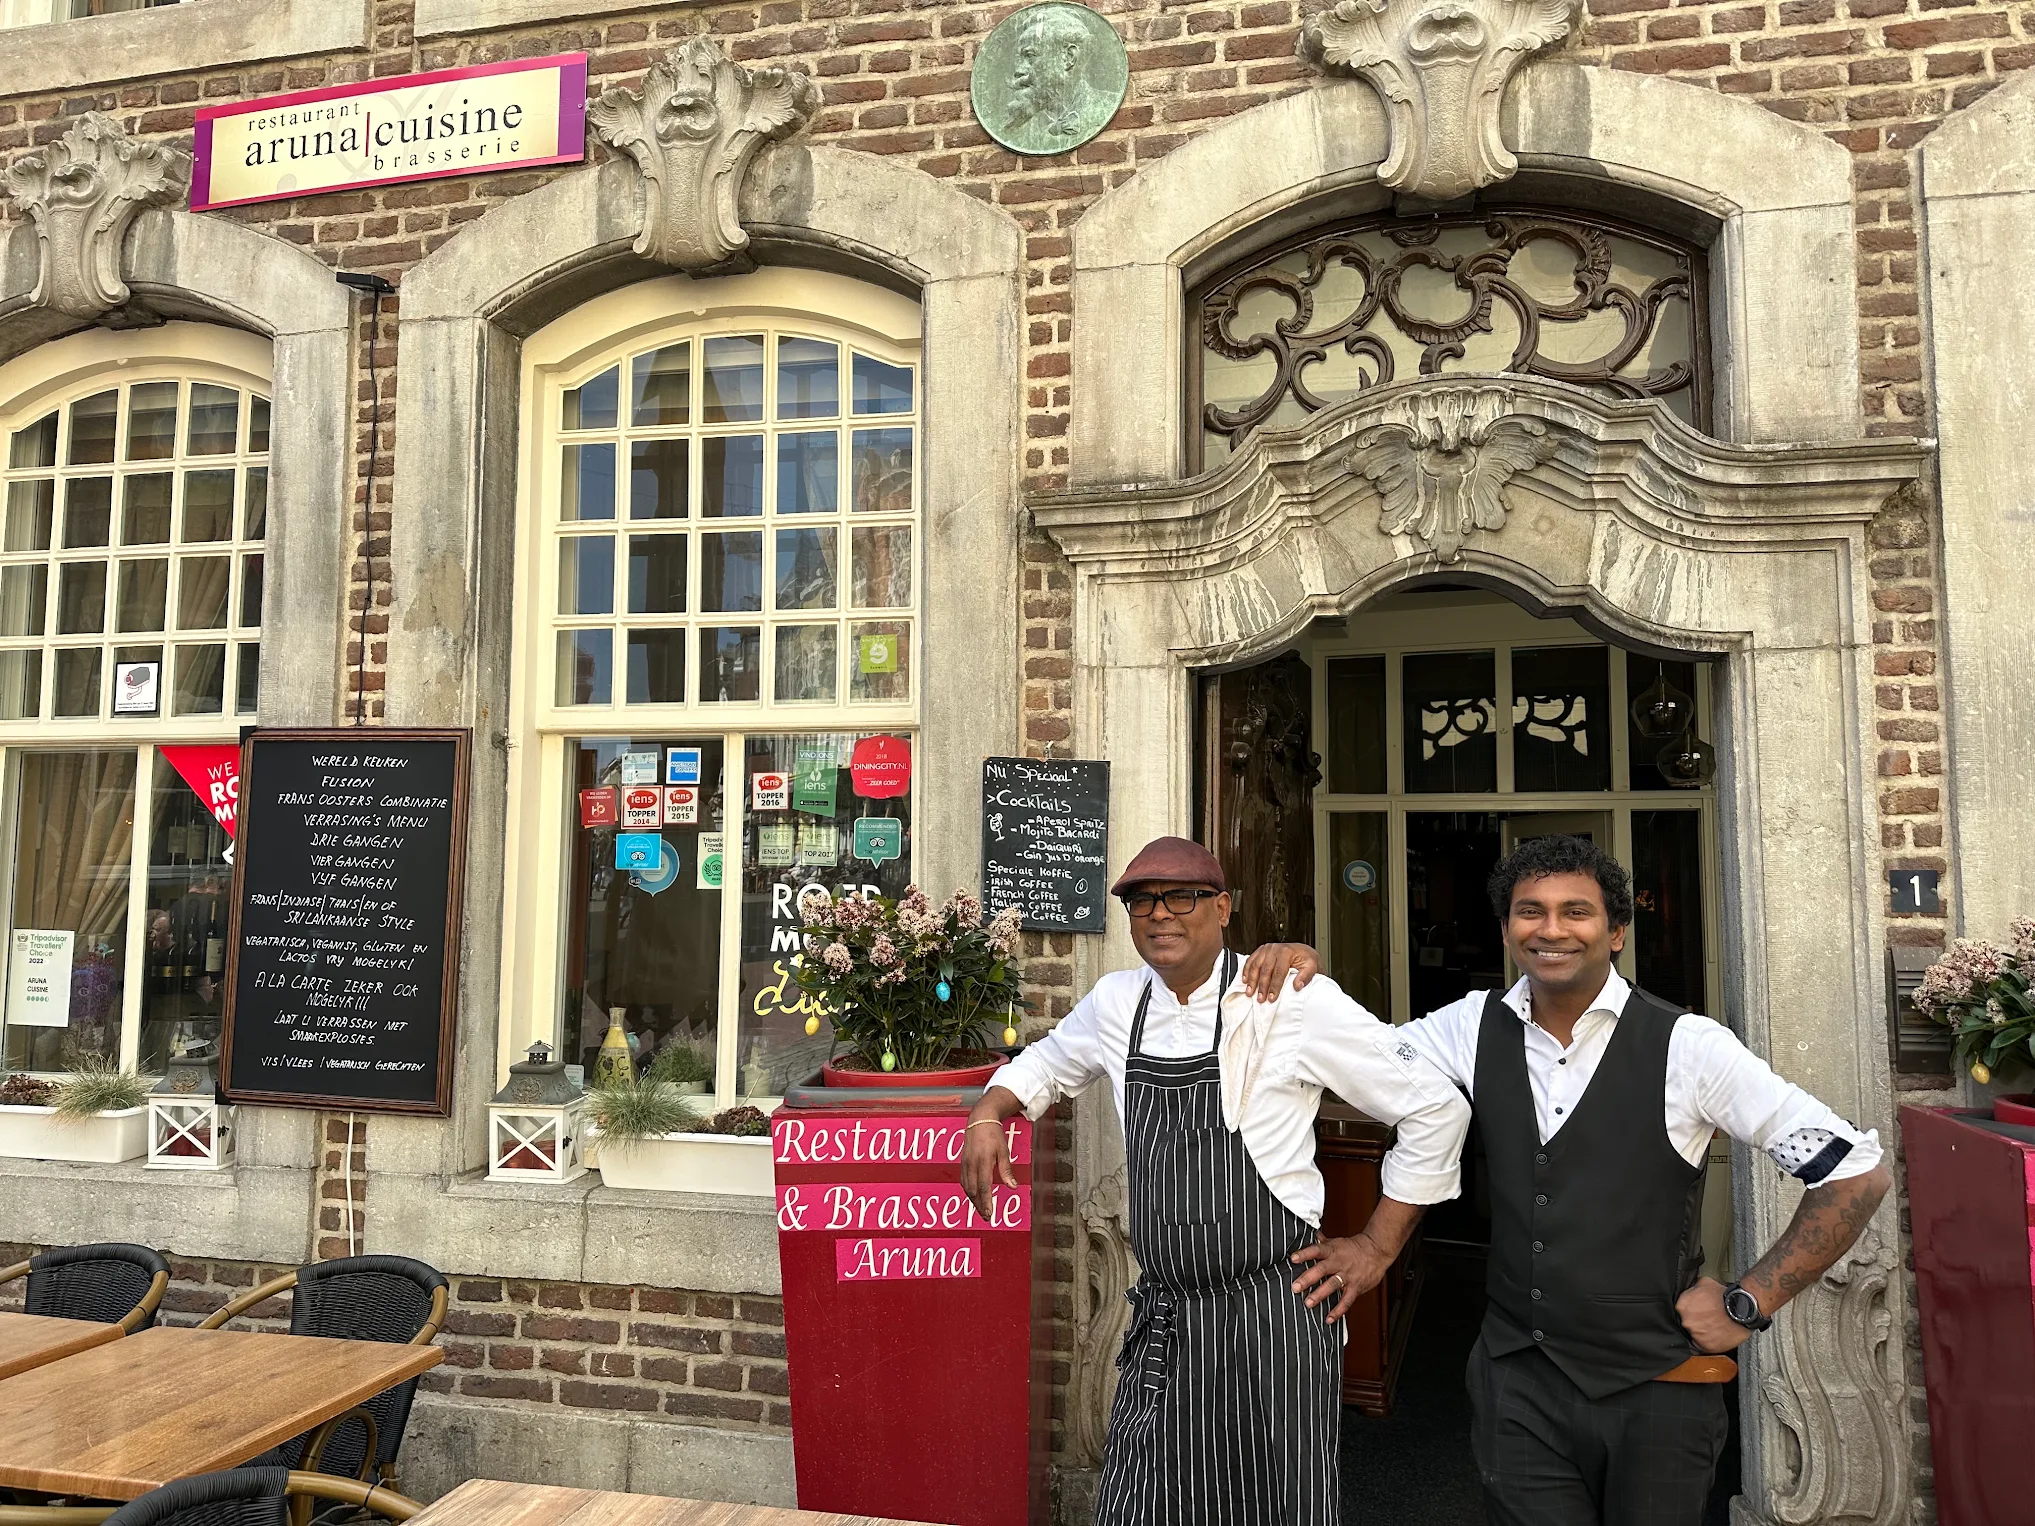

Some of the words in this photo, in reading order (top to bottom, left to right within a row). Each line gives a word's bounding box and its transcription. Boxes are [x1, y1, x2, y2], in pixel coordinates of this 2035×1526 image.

[248, 102, 360, 132] restaurant
[245, 123, 360, 167] aruna
[375, 99, 523, 146] cuisine
[374, 138, 520, 170] brasserie
[363, 756, 408, 767] KEUKEN
[854, 762, 908, 770] DININGCITY.NL
[207, 762, 234, 780] WE
[321, 776, 375, 788] FUSION
[804, 780, 826, 790] iens
[277, 793, 314, 805] FRANS
[319, 795, 373, 806] OOSTERS
[631, 793, 654, 804] iens
[672, 791, 690, 800] iens
[628, 810, 656, 818] TOPPER
[672, 812, 690, 820] 2015
[387, 815, 429, 828] MENU
[310, 833, 339, 847] DRIE
[343, 834, 404, 849] GANGEN
[311, 855, 332, 867] VIER
[335, 855, 395, 870] GANGEN
[340, 874, 397, 890] GANGEN
[1910, 876, 1920, 906] 1
[381, 901, 397, 911] OF
[378, 914, 415, 930] STYLE
[31, 934, 67, 942] Tripadvisor
[29, 949, 53, 957] Choice
[413, 944, 428, 953] EN
[279, 950, 318, 963] LACTOS
[255, 971, 266, 987] A
[268, 973, 286, 988] LA
[291, 975, 333, 992] CARTE
[344, 979, 383, 994] ZEKER
[393, 984, 419, 997] OOK
[274, 1010, 298, 1024] LAAT
[317, 1016, 377, 1029] VERRASSEN
[384, 1021, 408, 1031] MET
[375, 1060, 425, 1071] GERECHTEN
[774, 1119, 1022, 1163] Restaurat
[777, 1186, 809, 1231] &
[845, 1238, 974, 1278] Aruna
